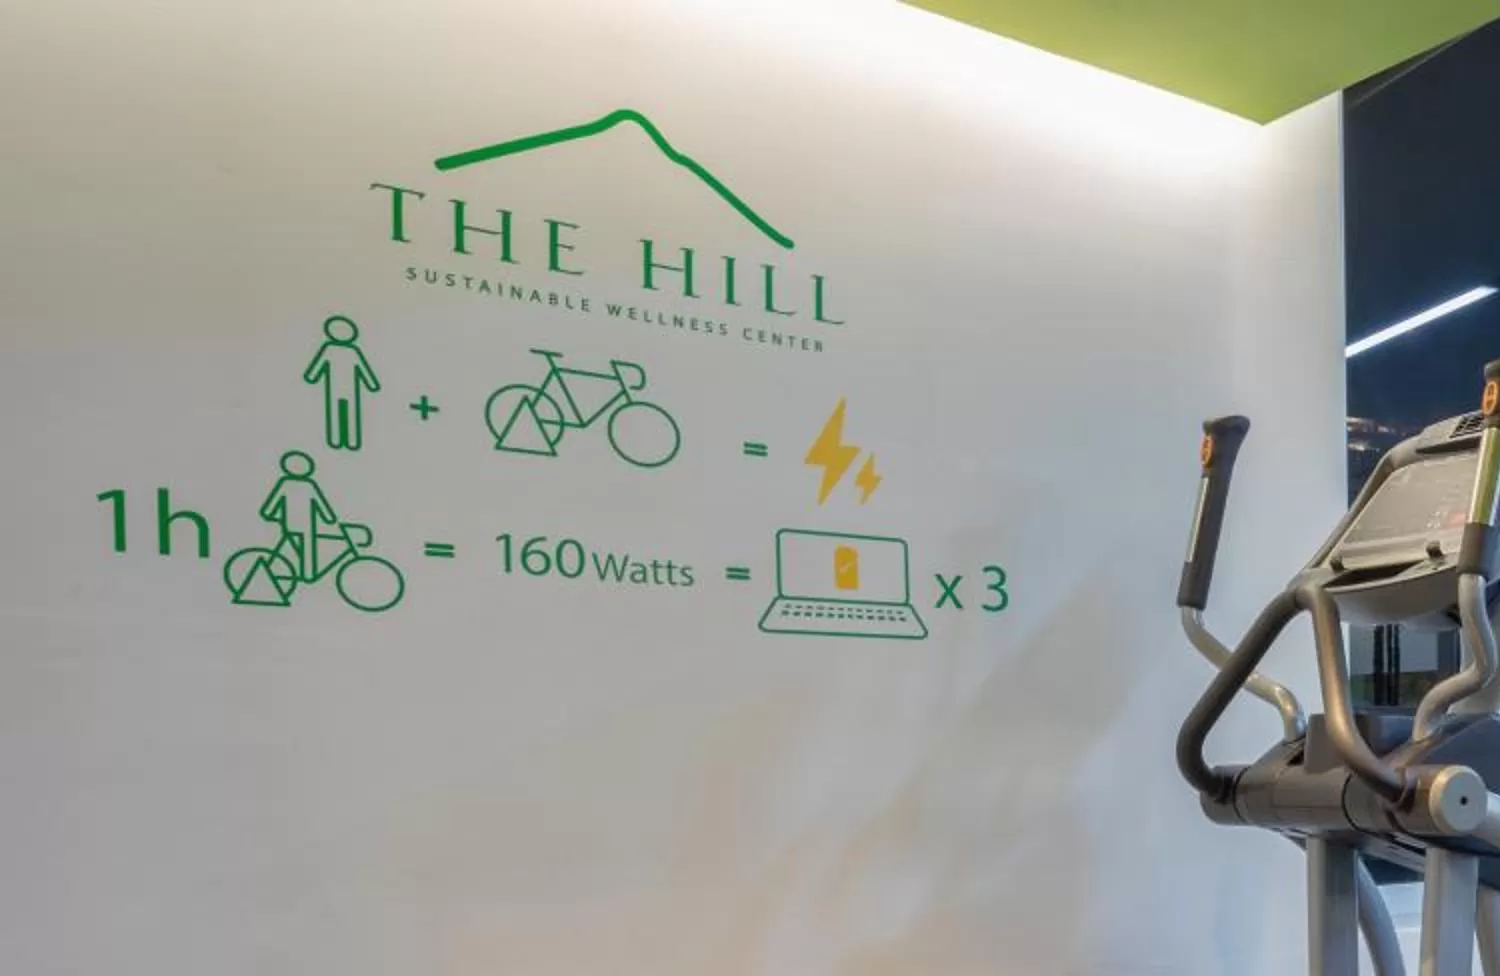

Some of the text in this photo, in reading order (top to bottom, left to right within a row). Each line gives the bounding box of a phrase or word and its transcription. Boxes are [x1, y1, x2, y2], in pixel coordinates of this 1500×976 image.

[368, 182, 846, 326] THE HILL
[405, 266, 824, 353] SUSTAINABLE WELLNESS CENTER
[495, 532, 587, 580] 160
[592, 551, 695, 588] Watts
